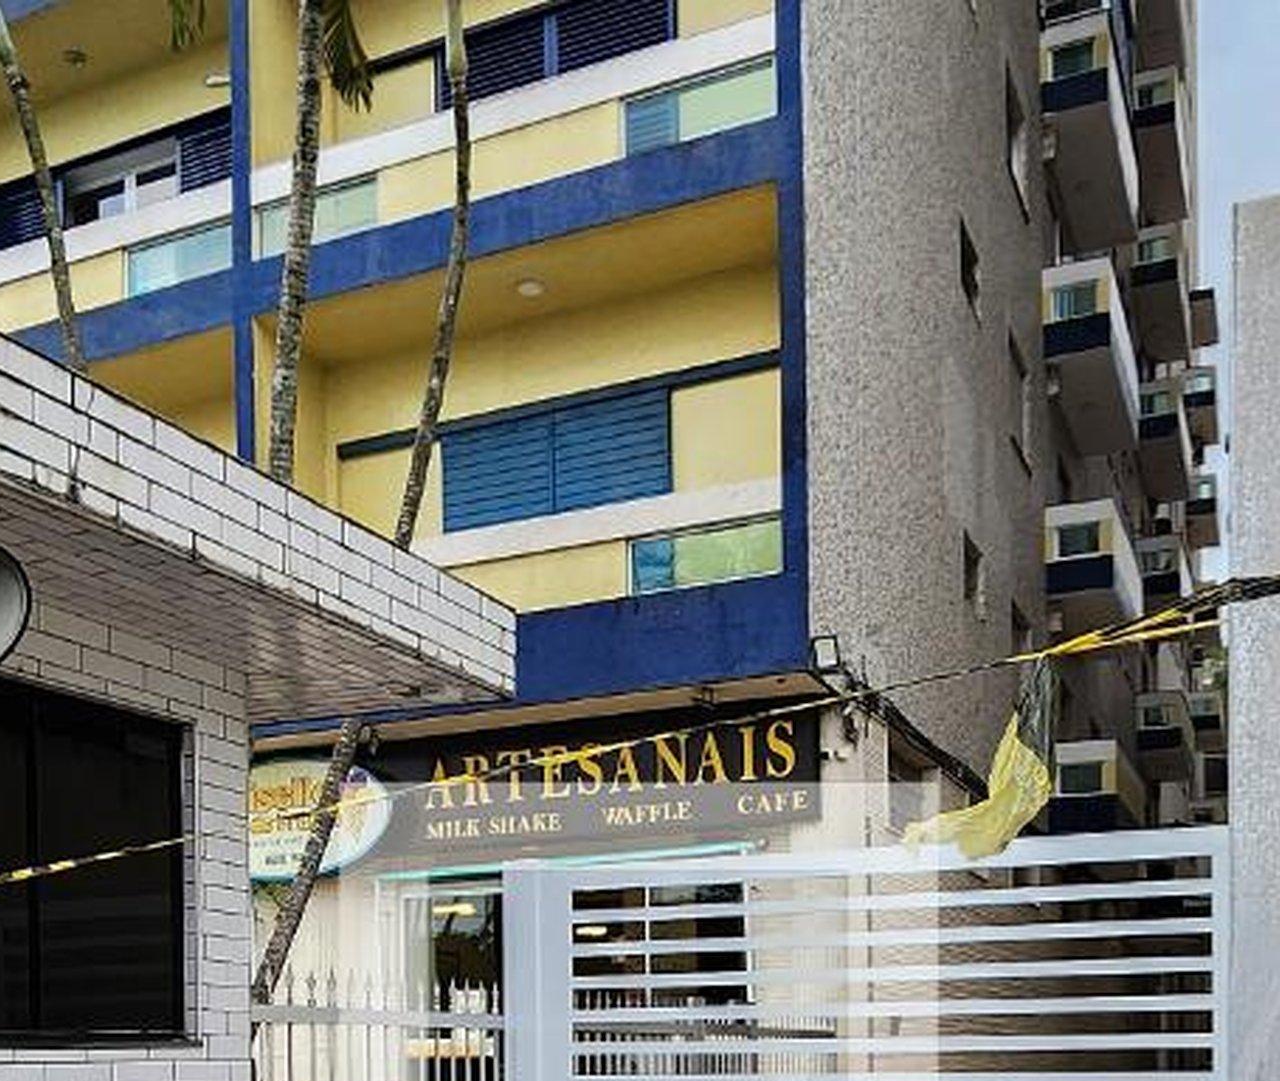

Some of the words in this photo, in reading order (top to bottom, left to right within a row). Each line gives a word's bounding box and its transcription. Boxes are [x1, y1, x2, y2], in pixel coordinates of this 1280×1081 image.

[425, 719, 797, 810] ARTESANAIS
[425, 818, 481, 841] MILK
[488, 812, 563, 838] SHAKE
[600, 801, 693, 826] WAFFLE
